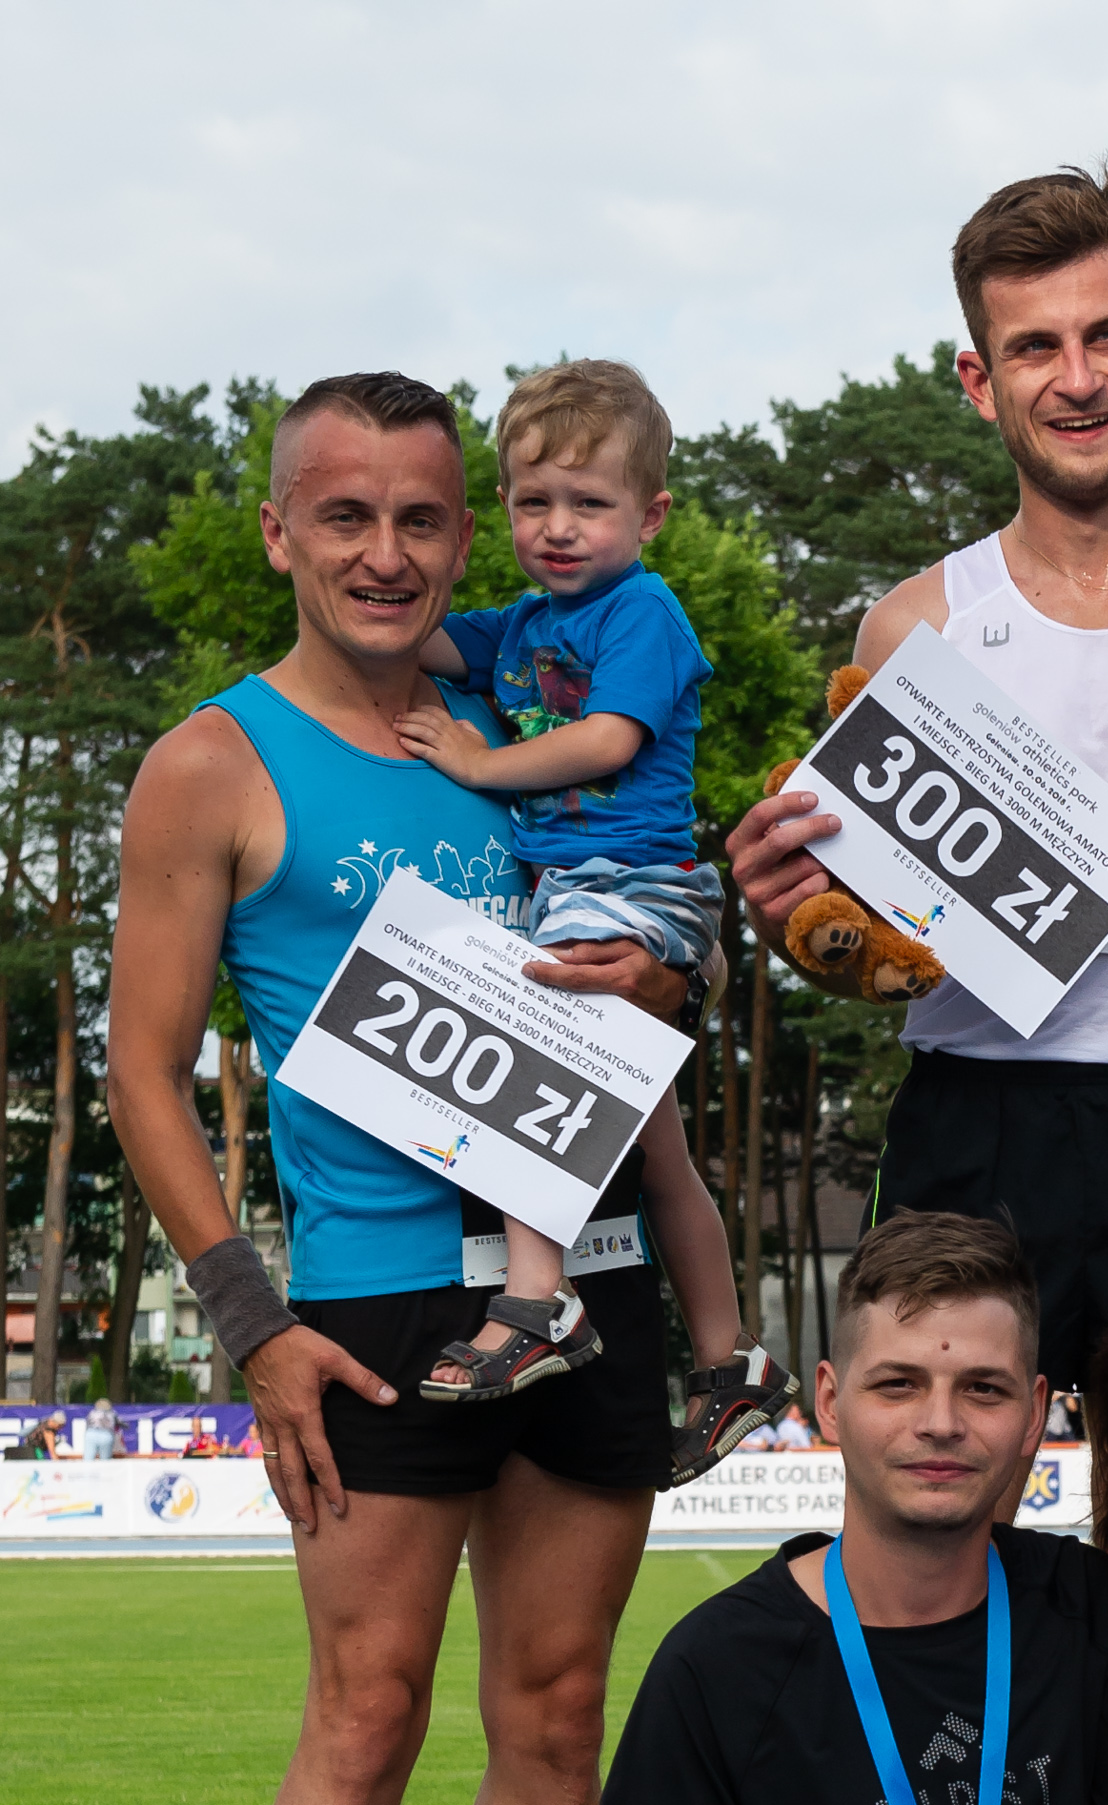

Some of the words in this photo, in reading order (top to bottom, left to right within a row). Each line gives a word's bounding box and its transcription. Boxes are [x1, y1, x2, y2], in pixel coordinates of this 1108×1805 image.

[896, 676, 945, 721] OTWARTE
[943, 717, 1013, 784] MISTRZOSTWA
[1014, 781, 1074, 836] GOLENIOWA
[972, 702, 1022, 744] goleniów
[1022, 745, 1070, 789] athletics
[1068, 787, 1098, 814] park
[1012, 716, 1077, 777] BESTSELLER
[1022, 764, 1066, 806] 20.06.2018
[913, 715, 921, 724] I
[919, 720, 961, 759] MIEJSCE
[965, 760, 990, 785] BIEG
[988, 781, 1005, 800] NA
[1004, 796, 1031, 820] 3000
[1029, 817, 1043, 831] M
[1041, 828, 1095, 876] MĘŻCZYZN
[854, 736, 1002, 877] 300
[991, 867, 1078, 944] zł
[893, 848, 957, 907] BESTSELLER
[384, 923, 438, 960] OTWARTE
[438, 955, 516, 1006] MISTRZOSTWA
[518, 1002, 583, 1046] GOLENIOWA
[584, 1042, 654, 1085] AMATORÓW
[407, 957, 417, 968] II
[416, 963, 462, 994] MIEJSCE
[468, 993, 495, 1013] BIEG
[494, 1008, 511, 1025] NA
[512, 1019, 540, 1040] 3000
[540, 1035, 554, 1048] M
[554, 1043, 612, 1082] MĘŻCZYZN
[464, 935, 518, 968] goleniów
[573, 994, 605, 1021] park
[523, 985, 572, 1018] 20.06.2018
[353, 981, 514, 1104] 200
[513, 1083, 598, 1155] zł
[410, 1089, 480, 1134] BESTSELLER
[671, 1494, 790, 1515] ATHLETICS
[797, 1494, 845, 1514] PAR
[775, 1465, 845, 1486] GOLEN
